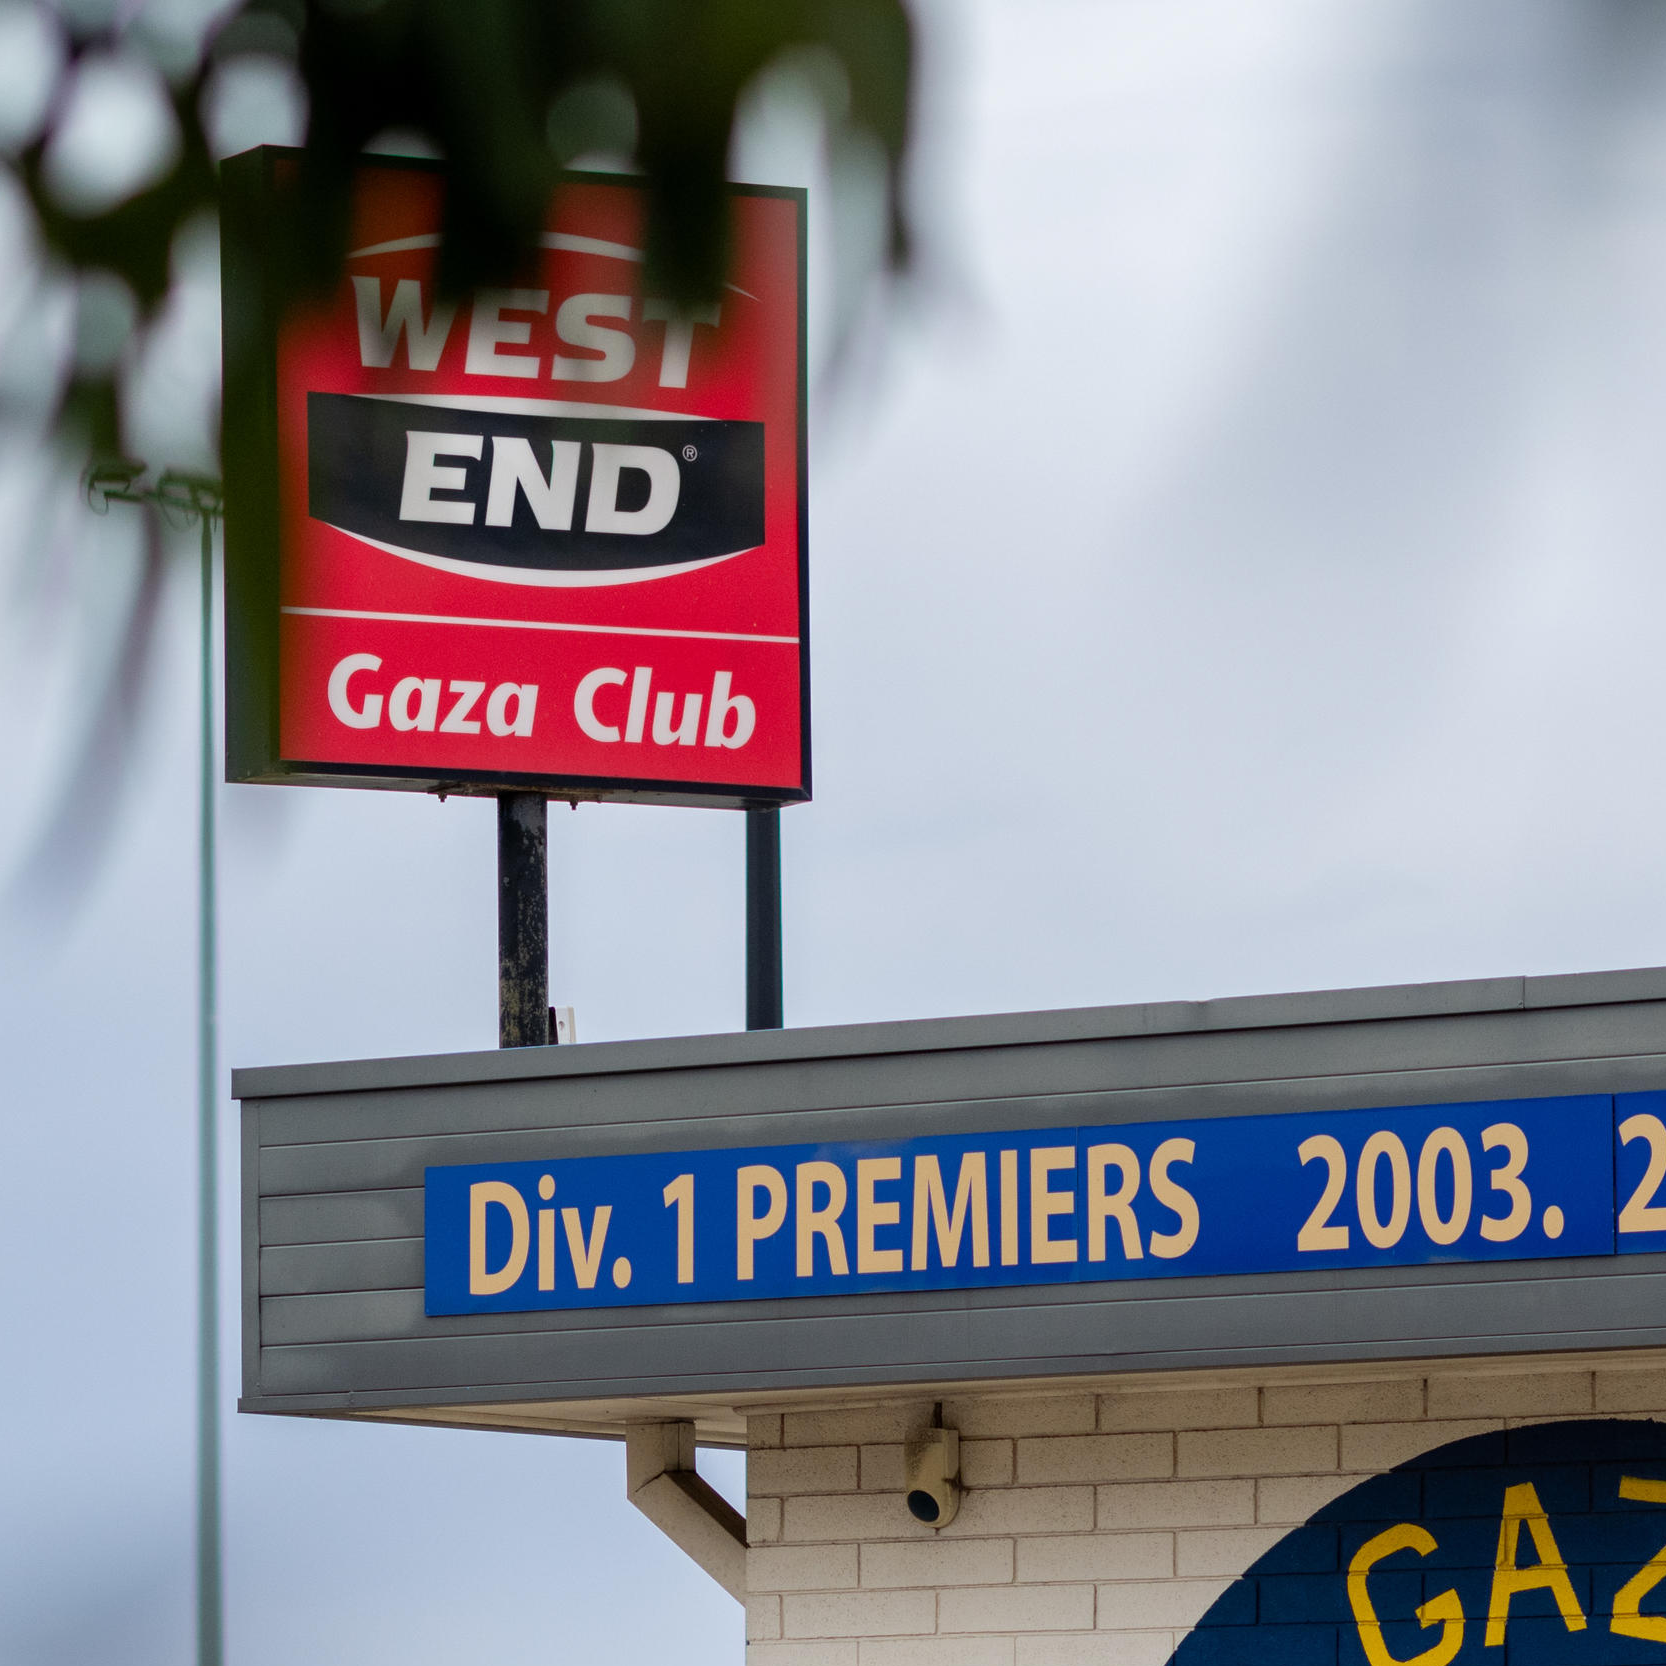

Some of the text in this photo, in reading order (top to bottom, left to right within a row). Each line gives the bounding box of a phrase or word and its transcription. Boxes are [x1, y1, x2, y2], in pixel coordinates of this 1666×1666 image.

[351, 275, 722, 389] WEST
[327, 653, 756, 750] Gaza Club
[469, 1174, 632, 1296] Div.
[663, 1173, 695, 1284] 1
[736, 1137, 1200, 1281] PREMIERS
[1297, 1122, 1565, 1252] 2003.
